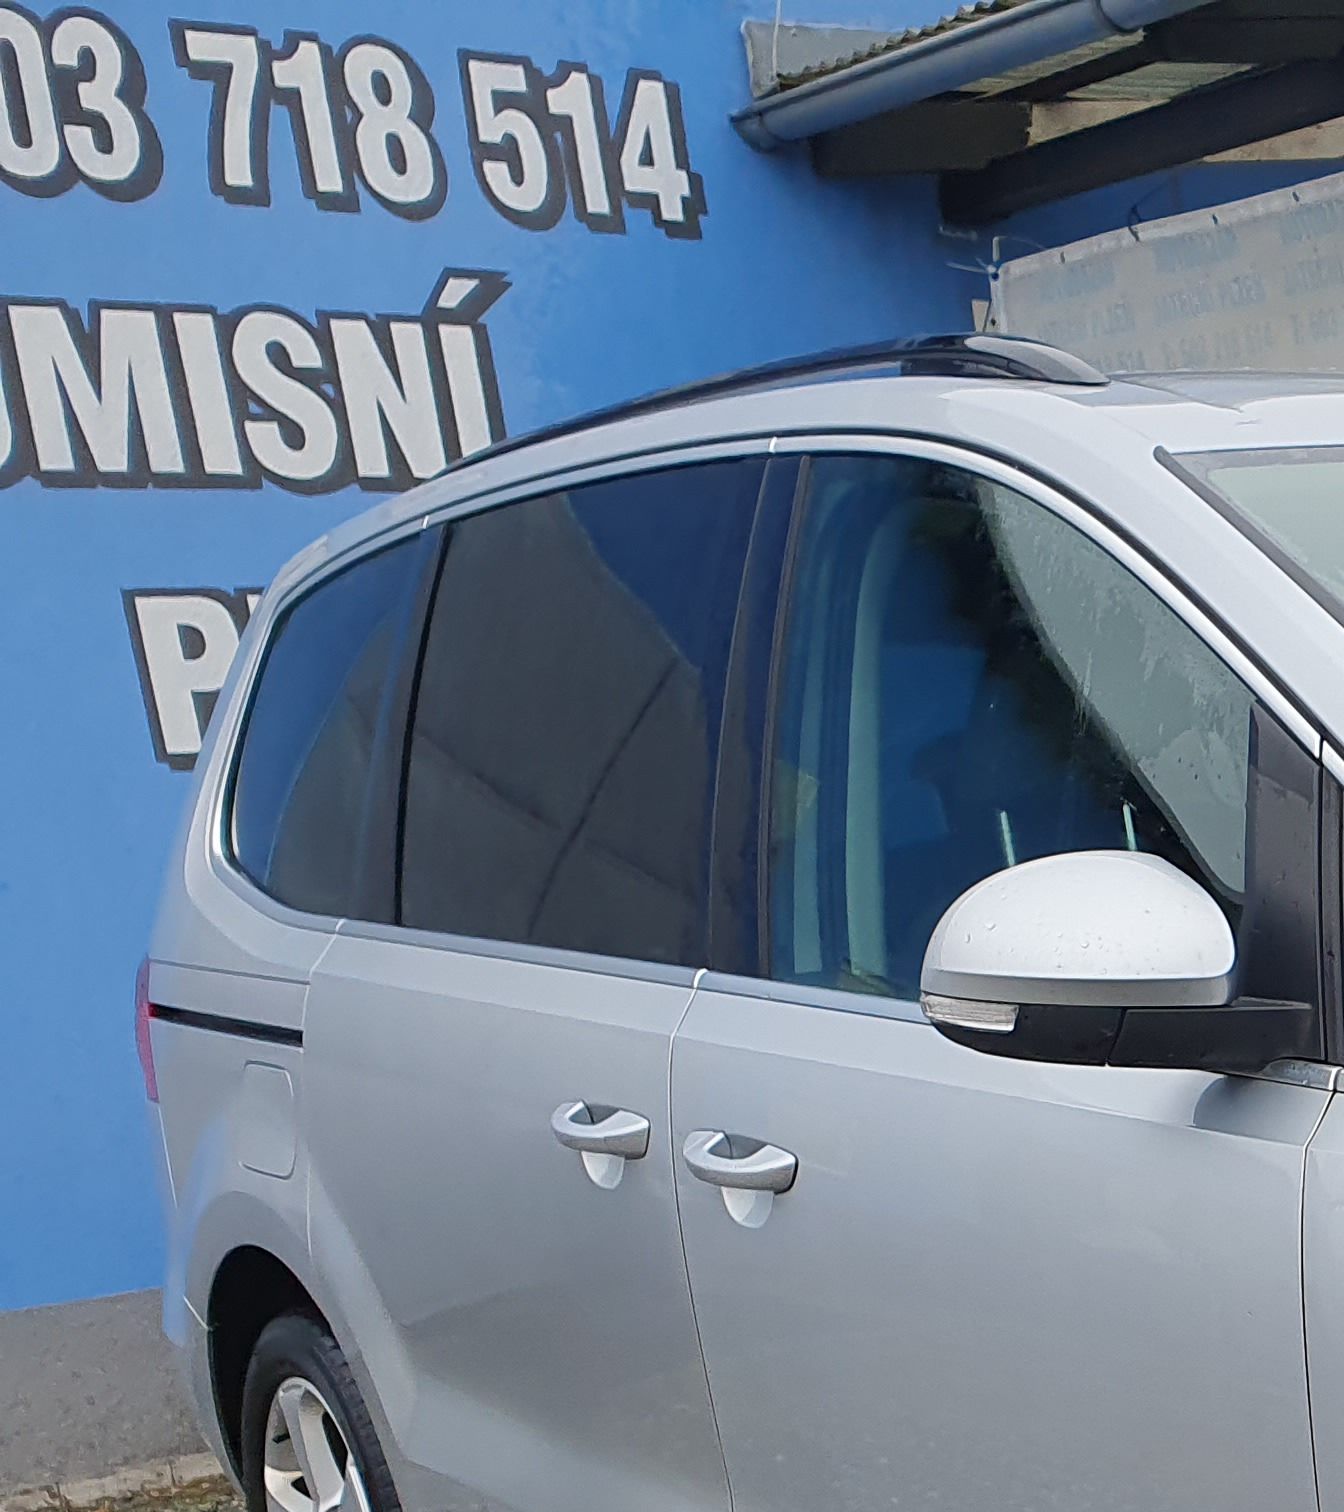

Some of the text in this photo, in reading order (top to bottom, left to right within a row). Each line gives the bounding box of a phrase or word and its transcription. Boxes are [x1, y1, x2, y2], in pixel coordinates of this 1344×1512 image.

[180, 24, 437, 208] 718
[465, 58, 694, 225] 514
[134, 593, 262, 757] P
